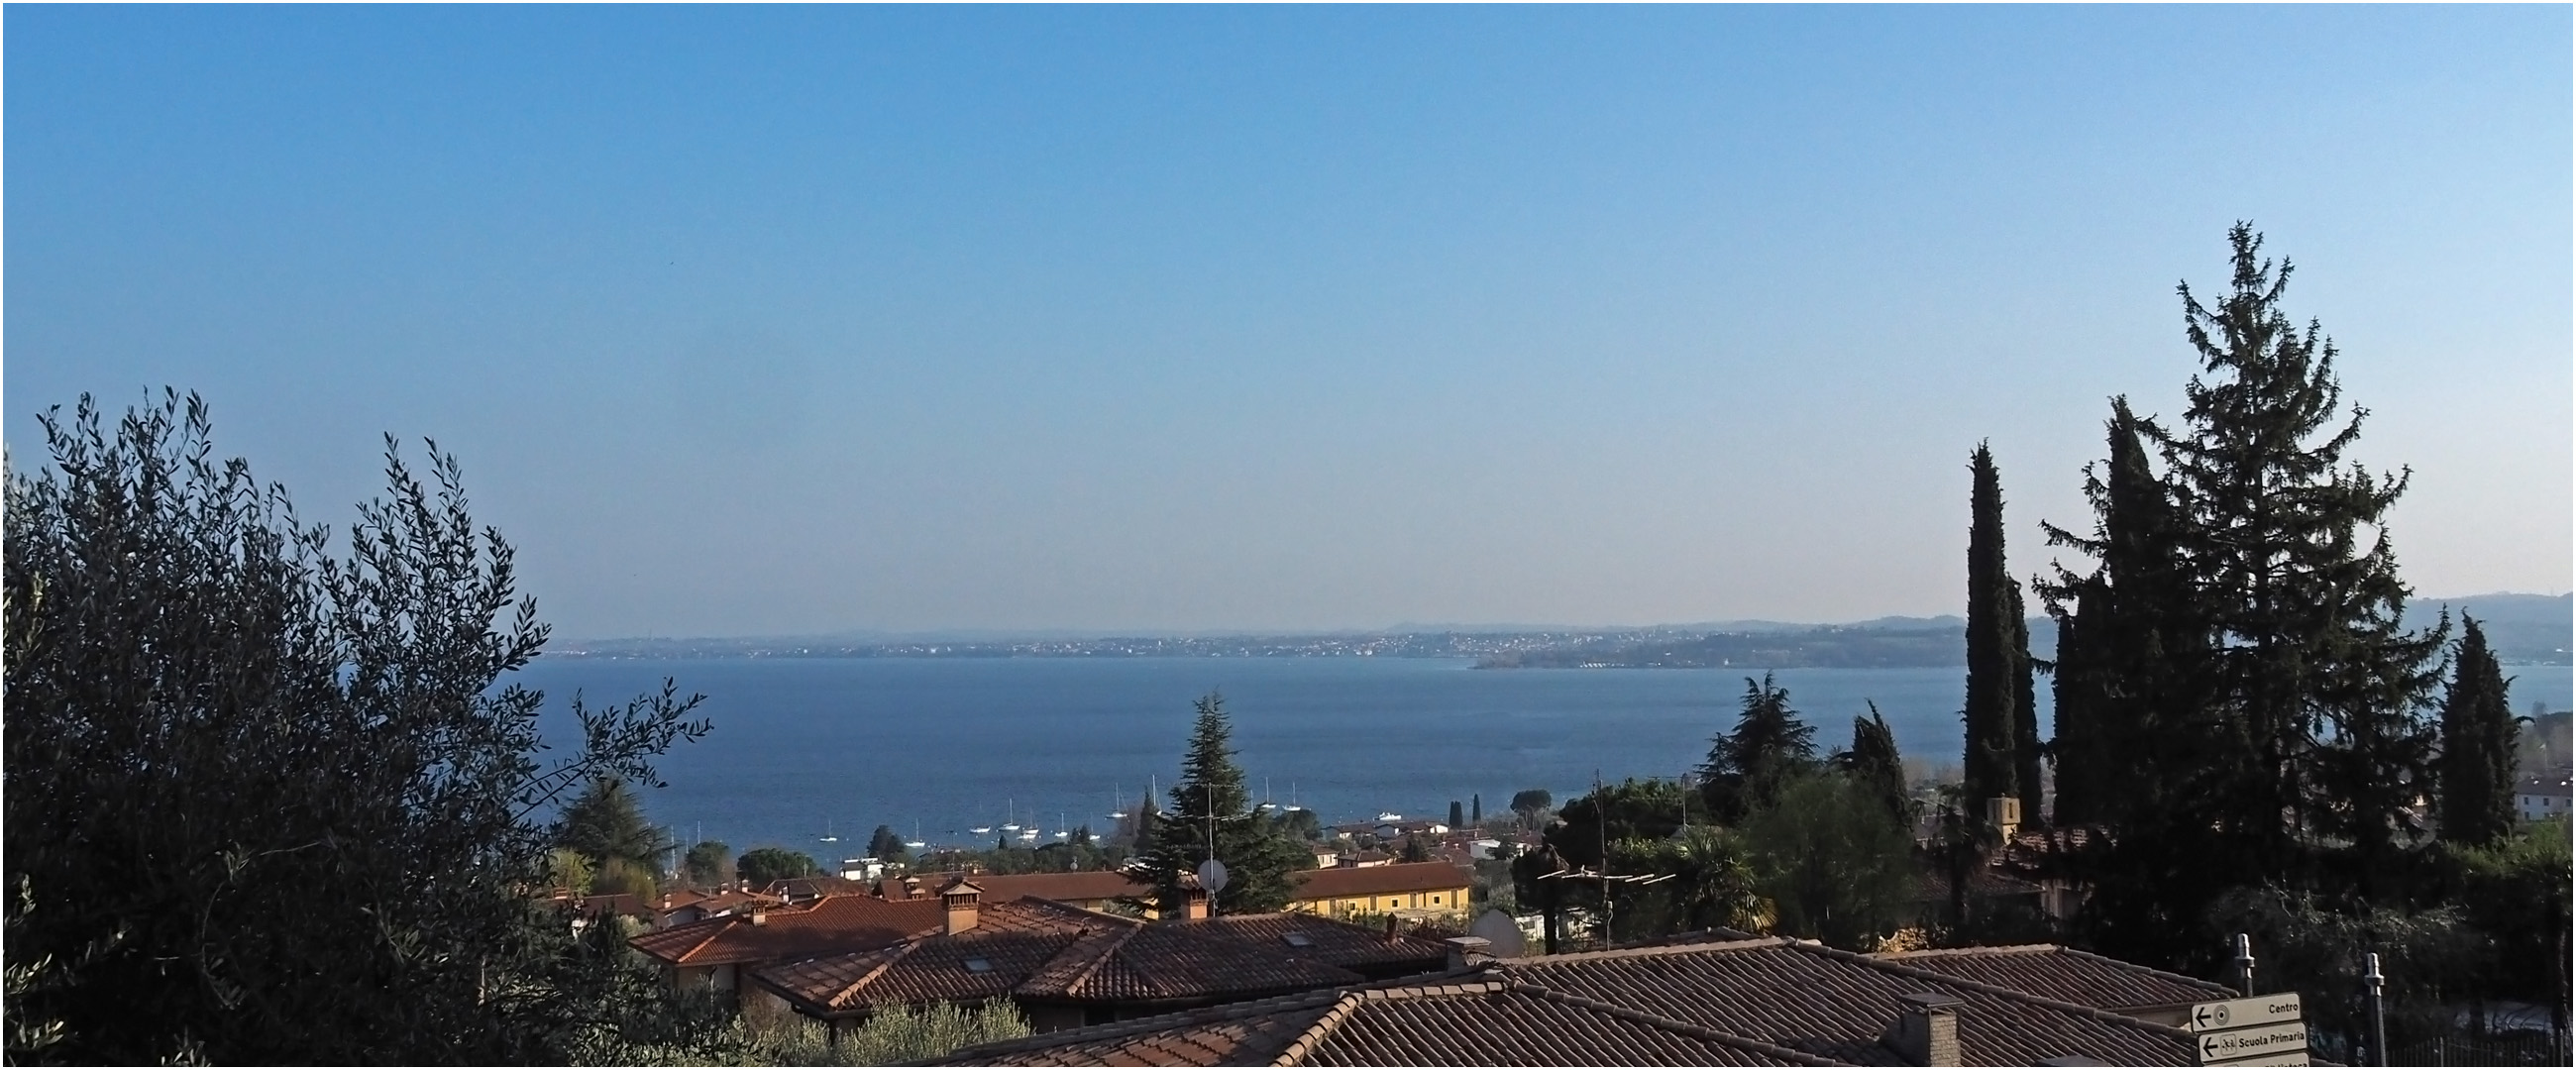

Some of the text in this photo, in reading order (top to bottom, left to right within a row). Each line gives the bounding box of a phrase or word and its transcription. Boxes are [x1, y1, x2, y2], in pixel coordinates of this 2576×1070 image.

[2269, 1003, 2299, 1014] Centro
[2238, 1031, 2305, 1048] Scuola Primaria
